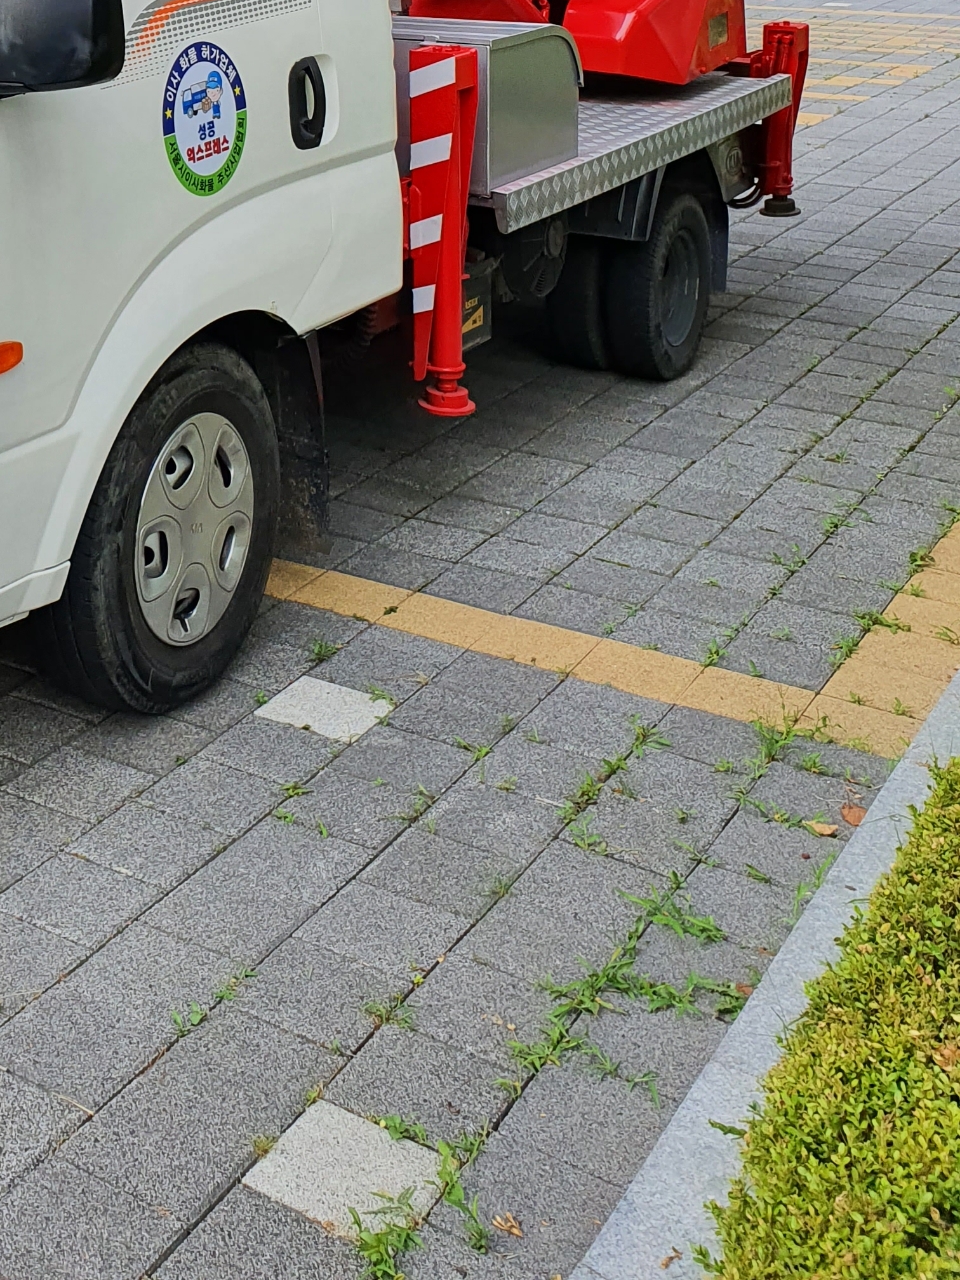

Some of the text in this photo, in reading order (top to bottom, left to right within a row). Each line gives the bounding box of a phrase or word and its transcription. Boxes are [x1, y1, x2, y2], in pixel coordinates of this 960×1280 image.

[166, 70, 181, 102] 이사
[179, 47, 198, 72] 화물
[198, 120, 216, 141] 성공
[186, 135, 230, 164] 익스프레스
